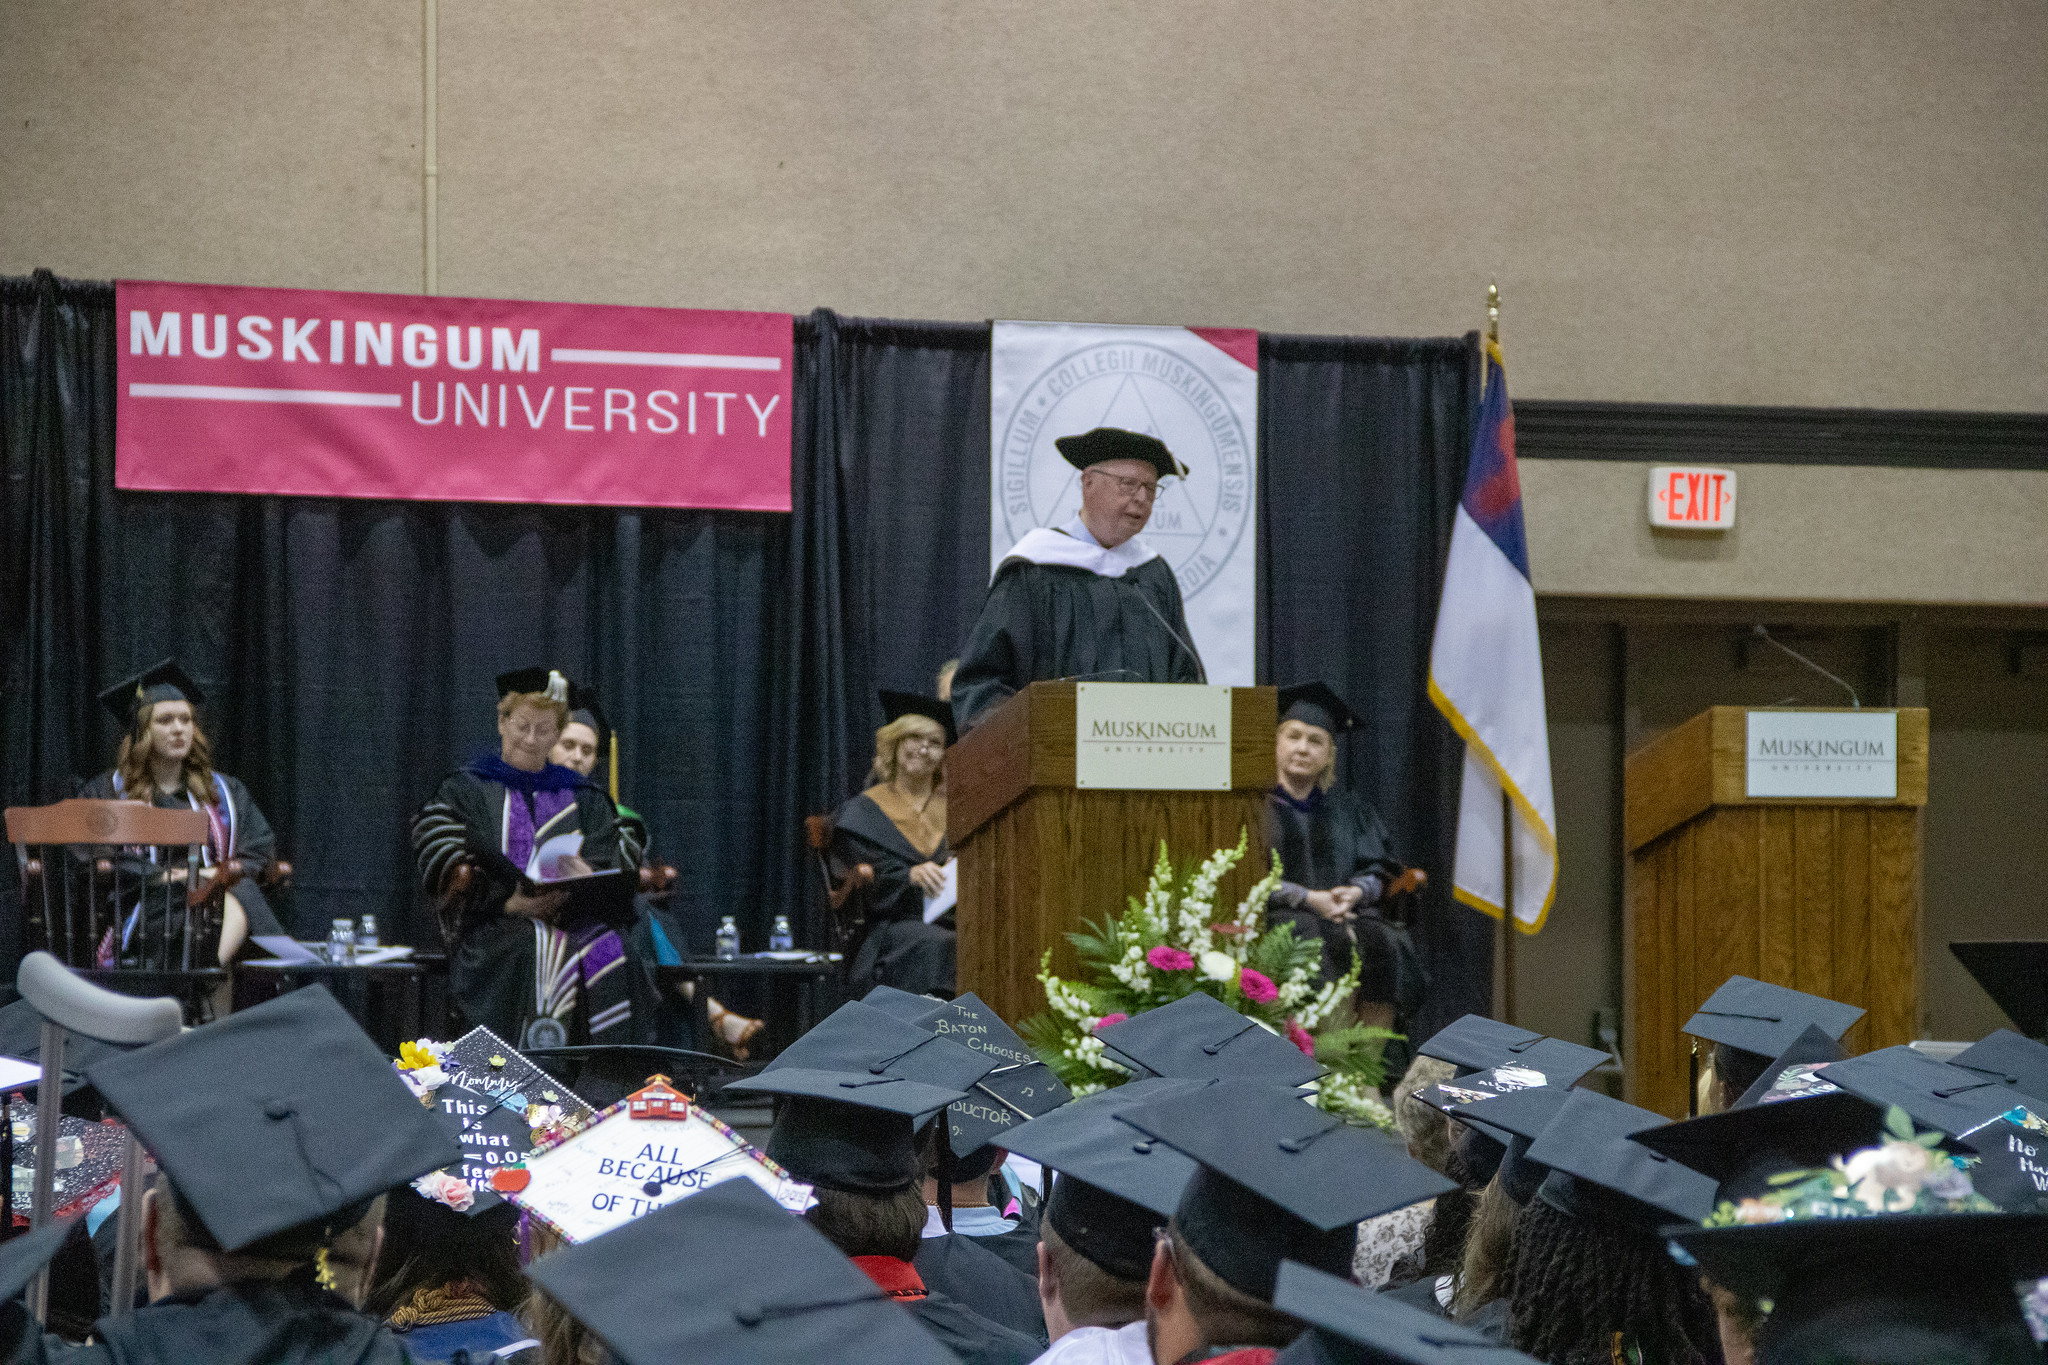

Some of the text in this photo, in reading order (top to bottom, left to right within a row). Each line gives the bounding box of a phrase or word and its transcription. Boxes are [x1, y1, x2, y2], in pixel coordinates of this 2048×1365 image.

[129, 309, 540, 372] MUSKINGUM
[411, 380, 781, 437] UNIVERSITY
[1007, 351, 1245, 516] SIGILLUM COLLEGII MUSKINGUMENSIS
[1667, 472, 1726, 522] EXIT
[1092, 719, 1217, 740] MUSKINGUM
[1759, 737, 1885, 758] MUSKINGUM
[953, 1004, 979, 1019] THE
[935, 1019, 987, 1036] BATON
[967, 1037, 1031, 1063] CHOOSES
[441, 1099, 488, 1116] This
[949, 1101, 1011, 1126] DUCTOR
[462, 1117, 483, 1130] is
[459, 1132, 510, 1147] what
[637, 1143, 684, 1166] ALL
[461, 1164, 493, 1179] fee
[598, 1157, 713, 1190] BECAUSE
[592, 1193, 624, 1213] OF
[630, 1197, 669, 1217] TH
